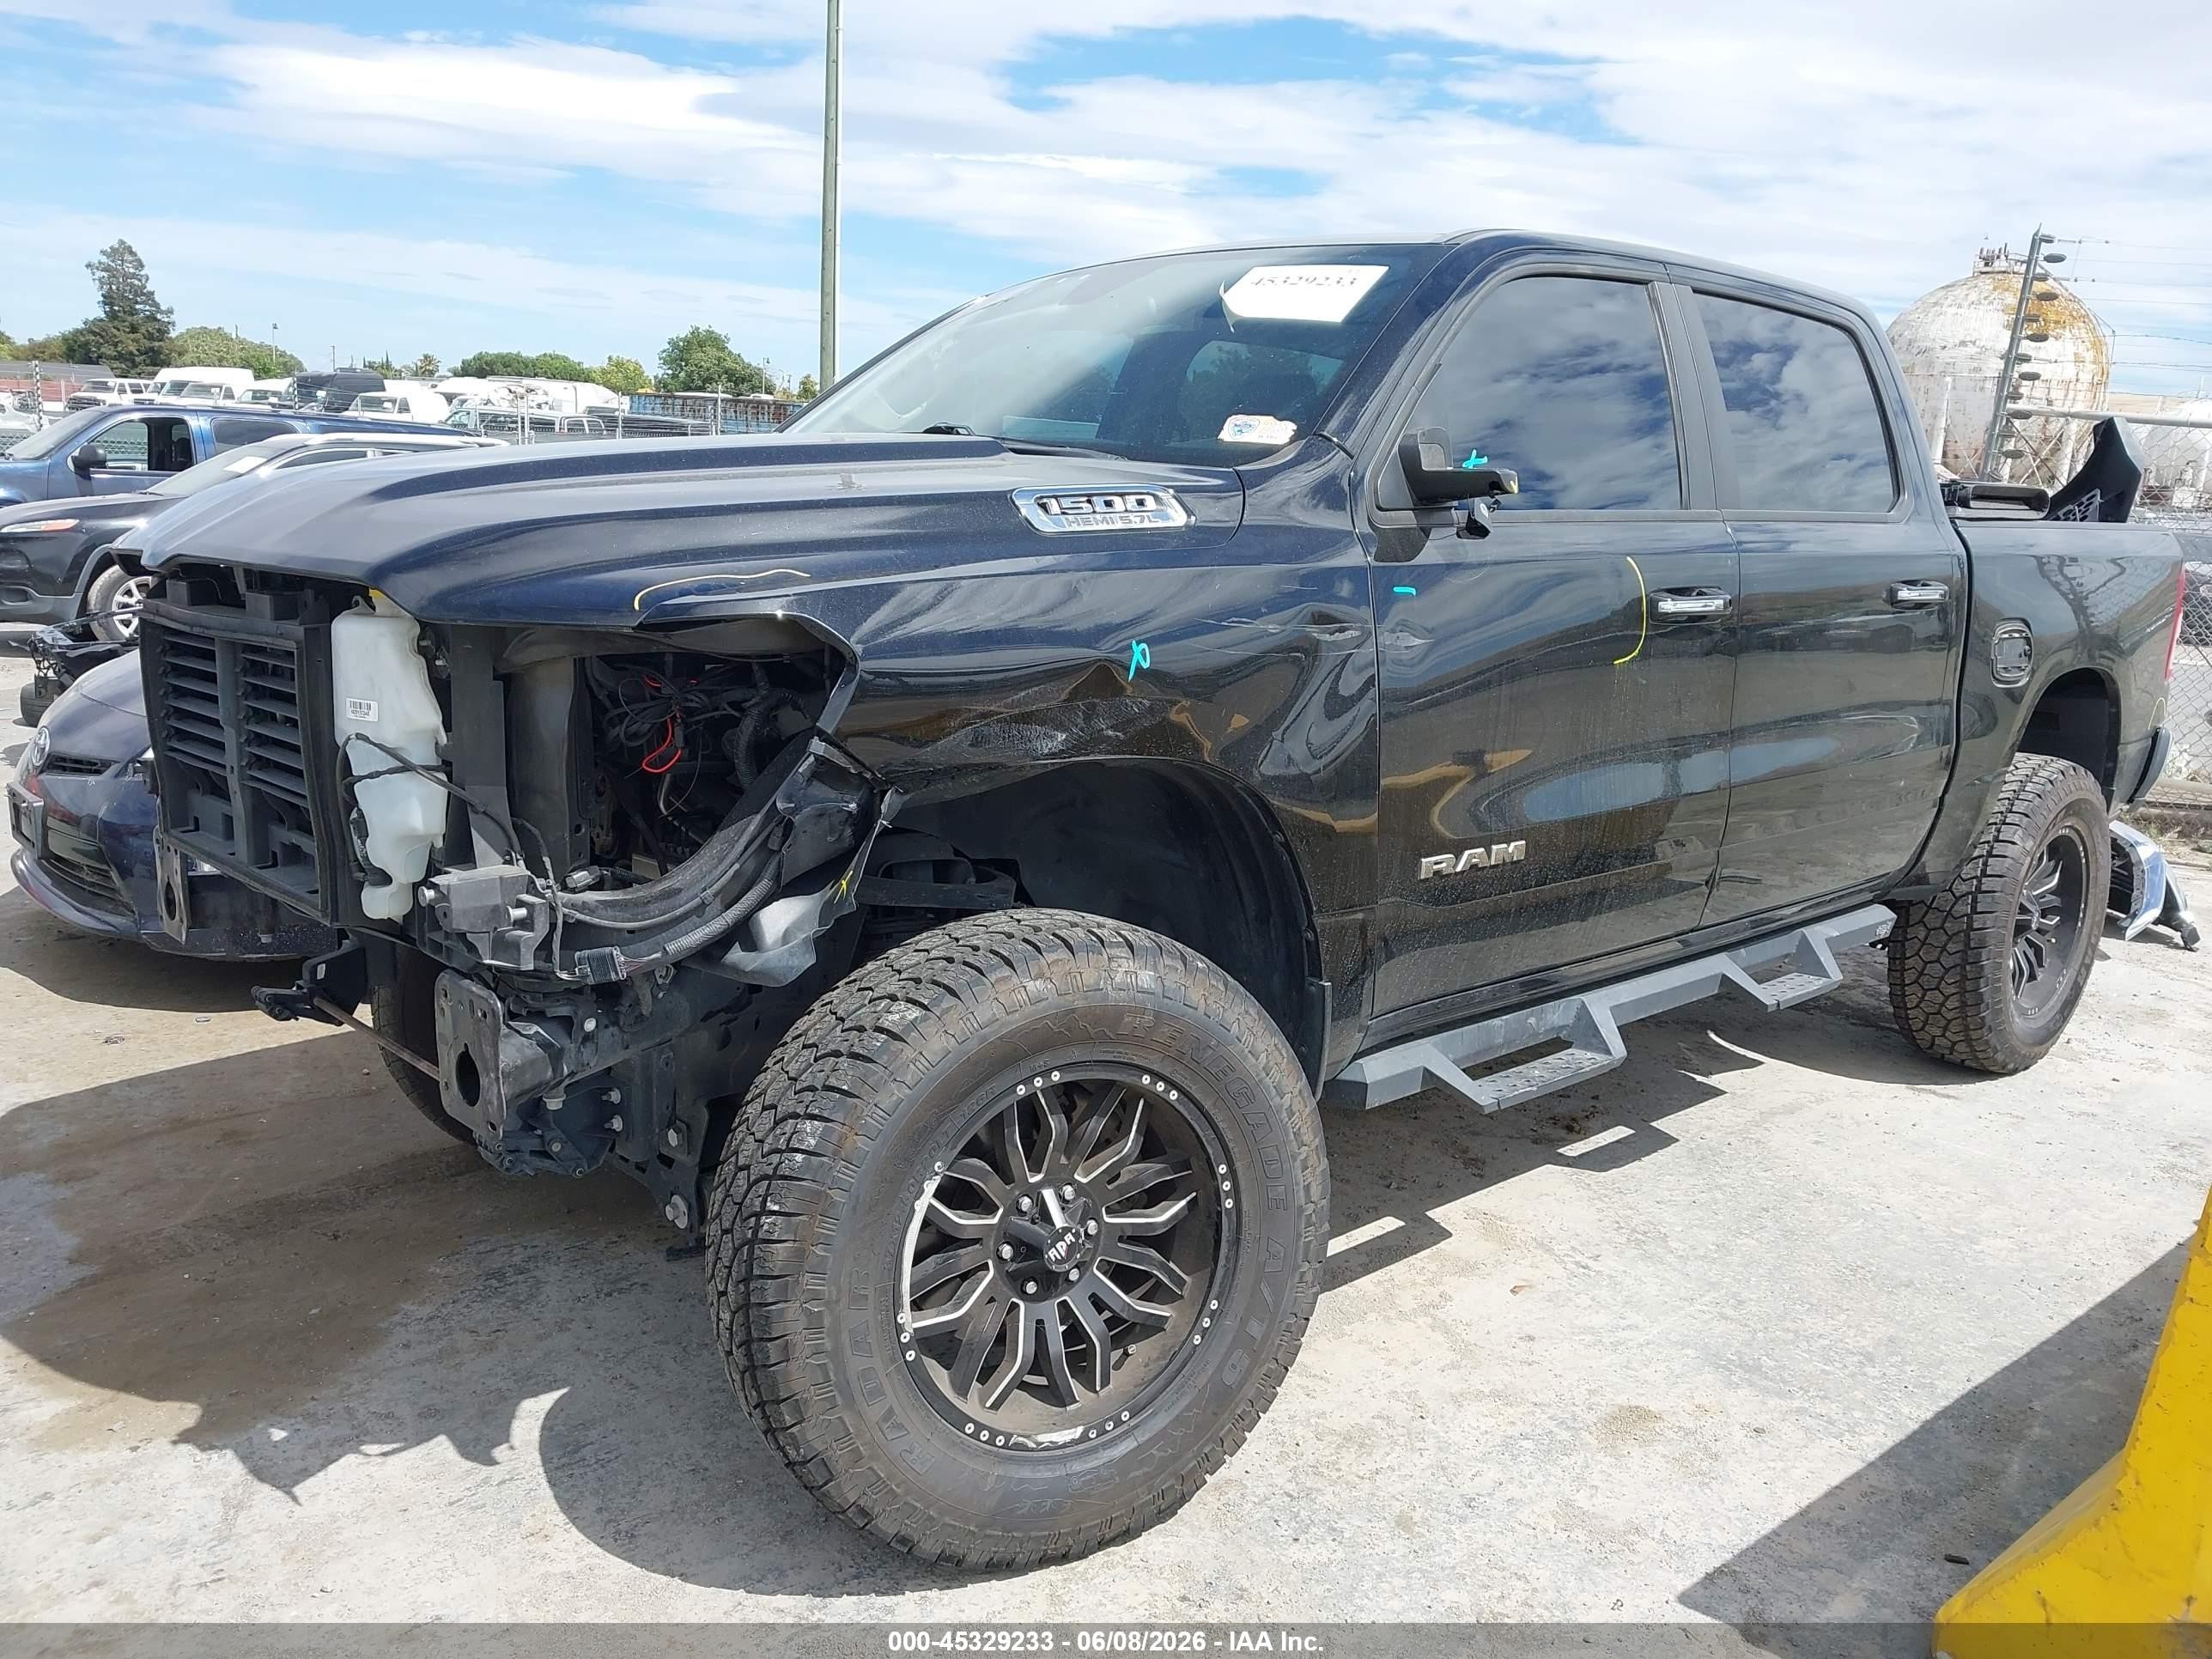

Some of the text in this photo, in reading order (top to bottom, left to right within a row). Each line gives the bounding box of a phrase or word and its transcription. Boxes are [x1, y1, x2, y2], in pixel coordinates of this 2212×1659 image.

[1037, 495, 1157, 515] 1500
[1066, 514, 1160, 528] HEMI 5.7L
[1419, 841, 1526, 879] RAM
[1116, 1012, 1289, 1211] RENEGADE
[848, 1268, 937, 1476] RADAR
